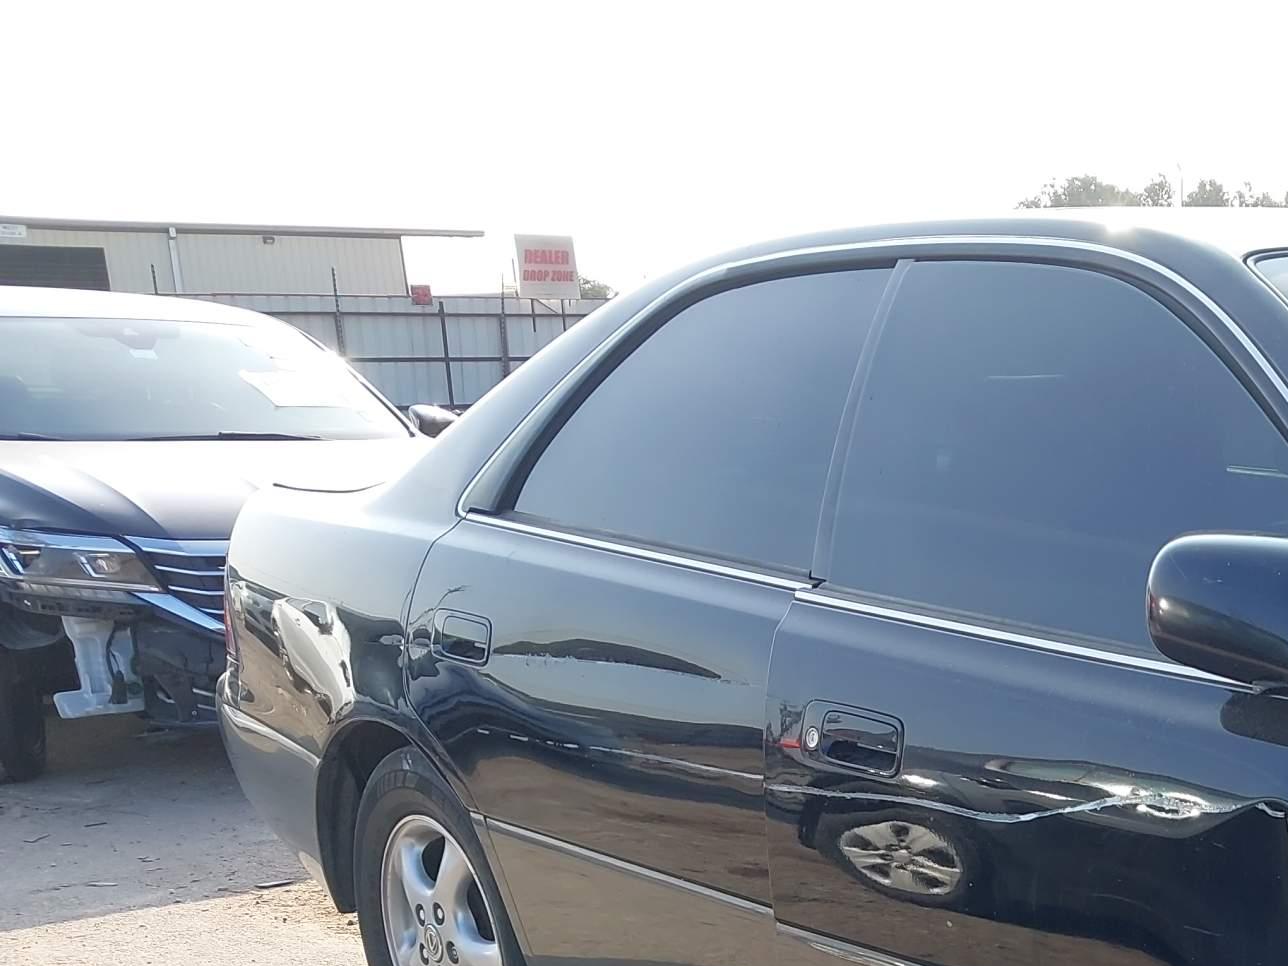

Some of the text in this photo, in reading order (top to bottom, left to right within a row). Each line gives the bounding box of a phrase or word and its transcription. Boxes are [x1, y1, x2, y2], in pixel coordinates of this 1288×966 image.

[524, 249, 569, 265] DEALER
[523, 270, 575, 282] DROP ZONE
